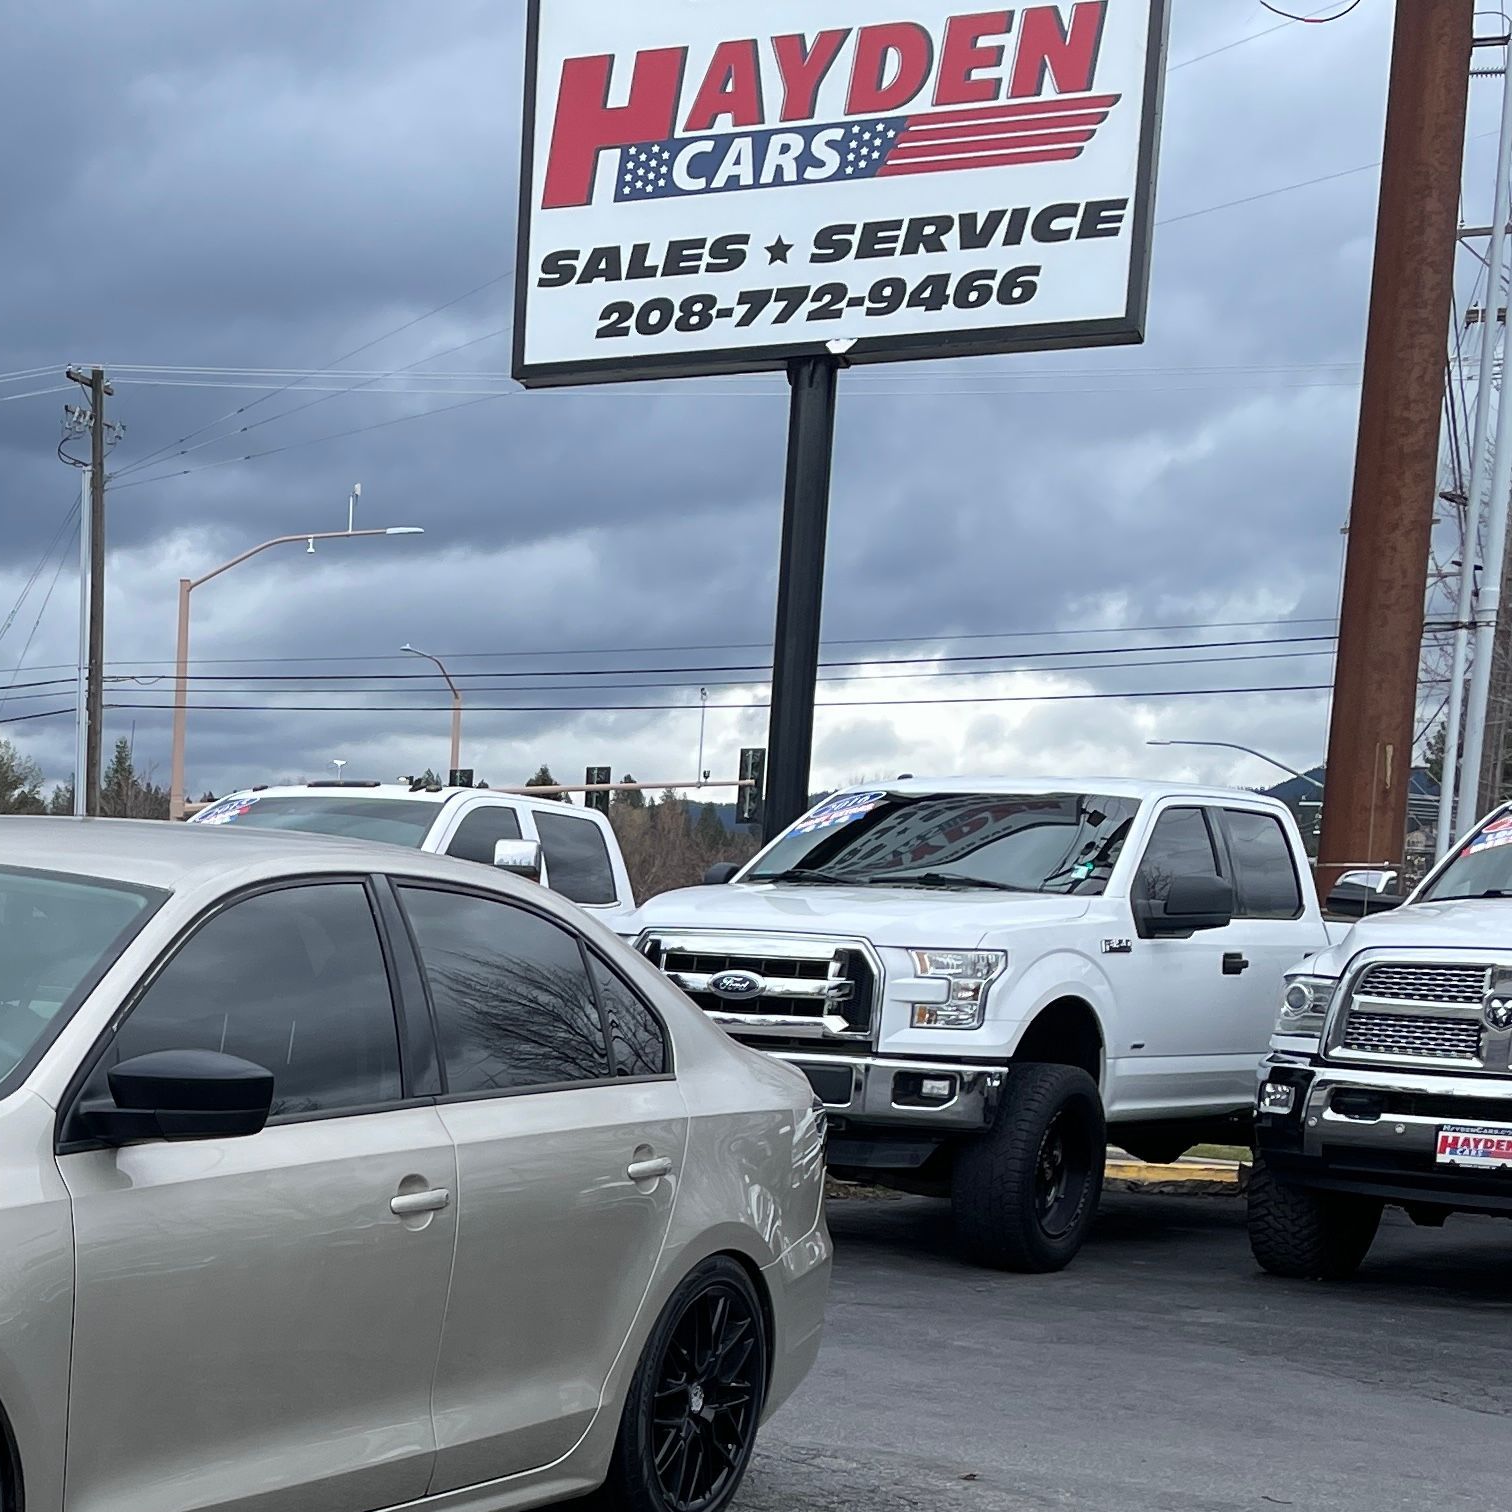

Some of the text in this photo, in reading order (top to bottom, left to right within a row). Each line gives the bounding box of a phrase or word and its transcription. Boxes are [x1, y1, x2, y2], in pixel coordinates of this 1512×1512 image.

[541, 1, 1108, 210] HAYDEN
[672, 127, 847, 192] CARS
[537, 197, 1129, 288] SALES SERVICE
[594, 265, 1042, 339] 208-772-9466
